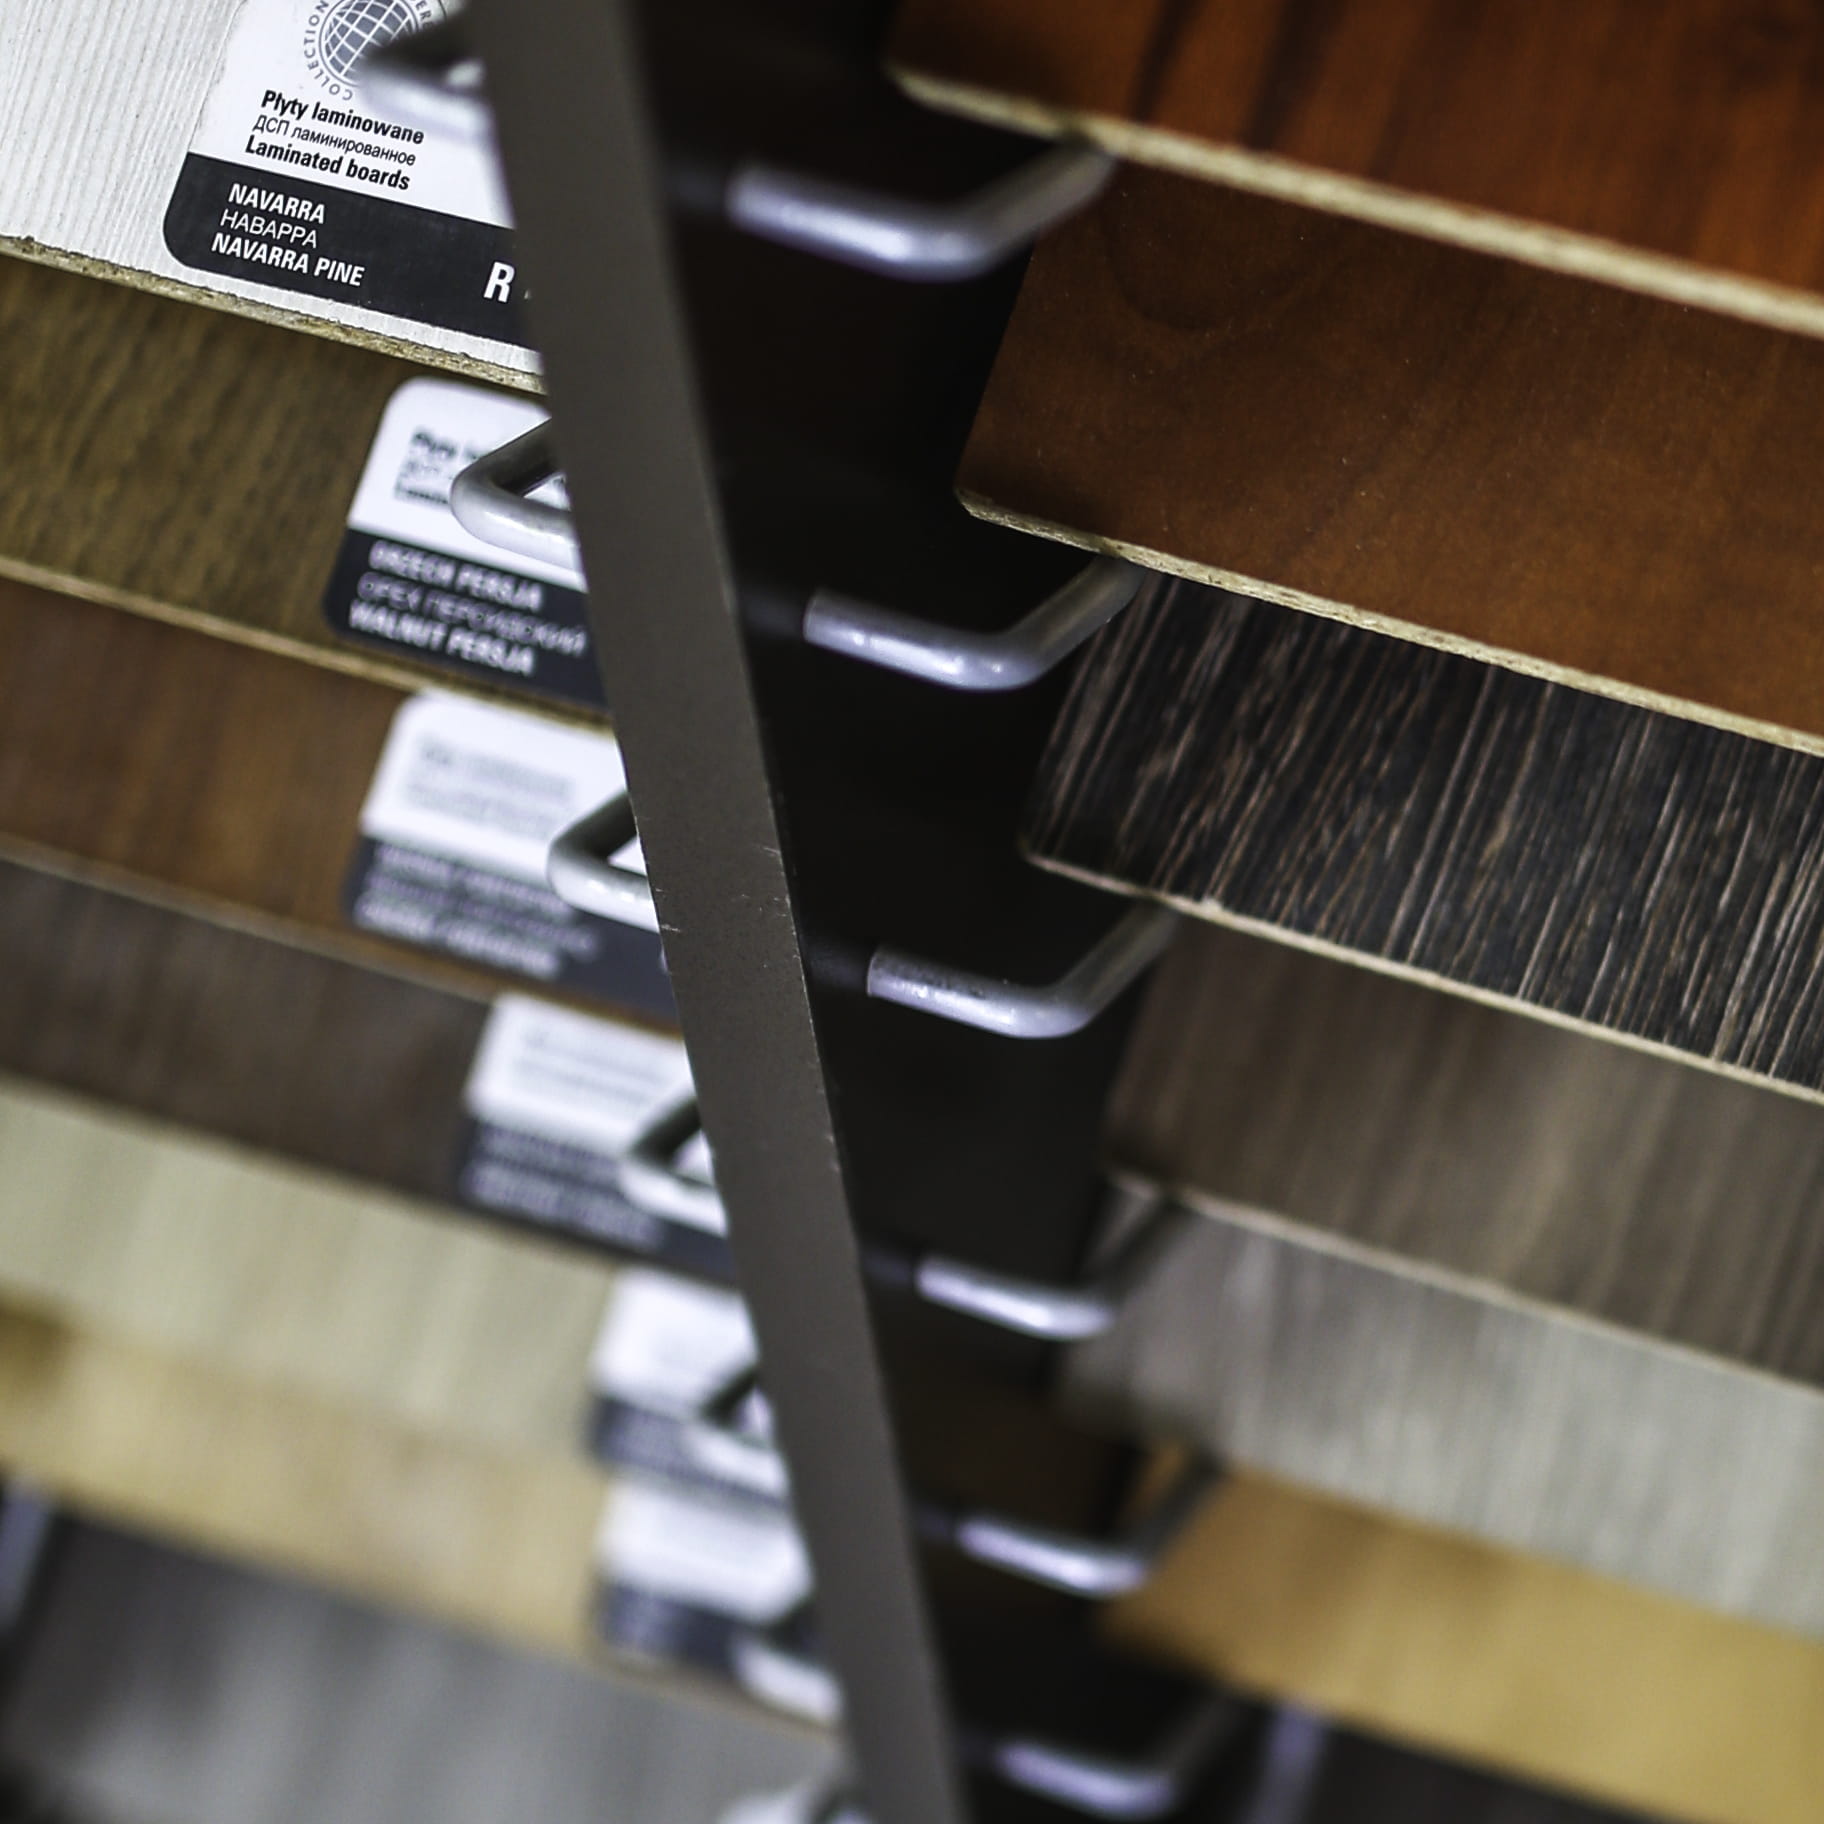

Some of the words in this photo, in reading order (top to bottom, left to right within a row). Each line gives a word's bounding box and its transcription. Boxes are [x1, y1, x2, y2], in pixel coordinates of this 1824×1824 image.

[304, 0, 353, 101] COLLECTION
[252, 114, 290, 136] ДСП
[291, 126, 416, 166] ламинированное
[261, 89, 309, 120] Płyty
[312, 102, 424, 145] laminowane
[245, 134, 344, 174] Laminated
[346, 159, 411, 190] boards
[220, 208, 318, 248] НАВАРРА
[228, 183, 326, 224] NAVARRA
[211, 232, 309, 274] NAVARRA
[314, 257, 365, 286] PINE
[483, 261, 515, 303] R
